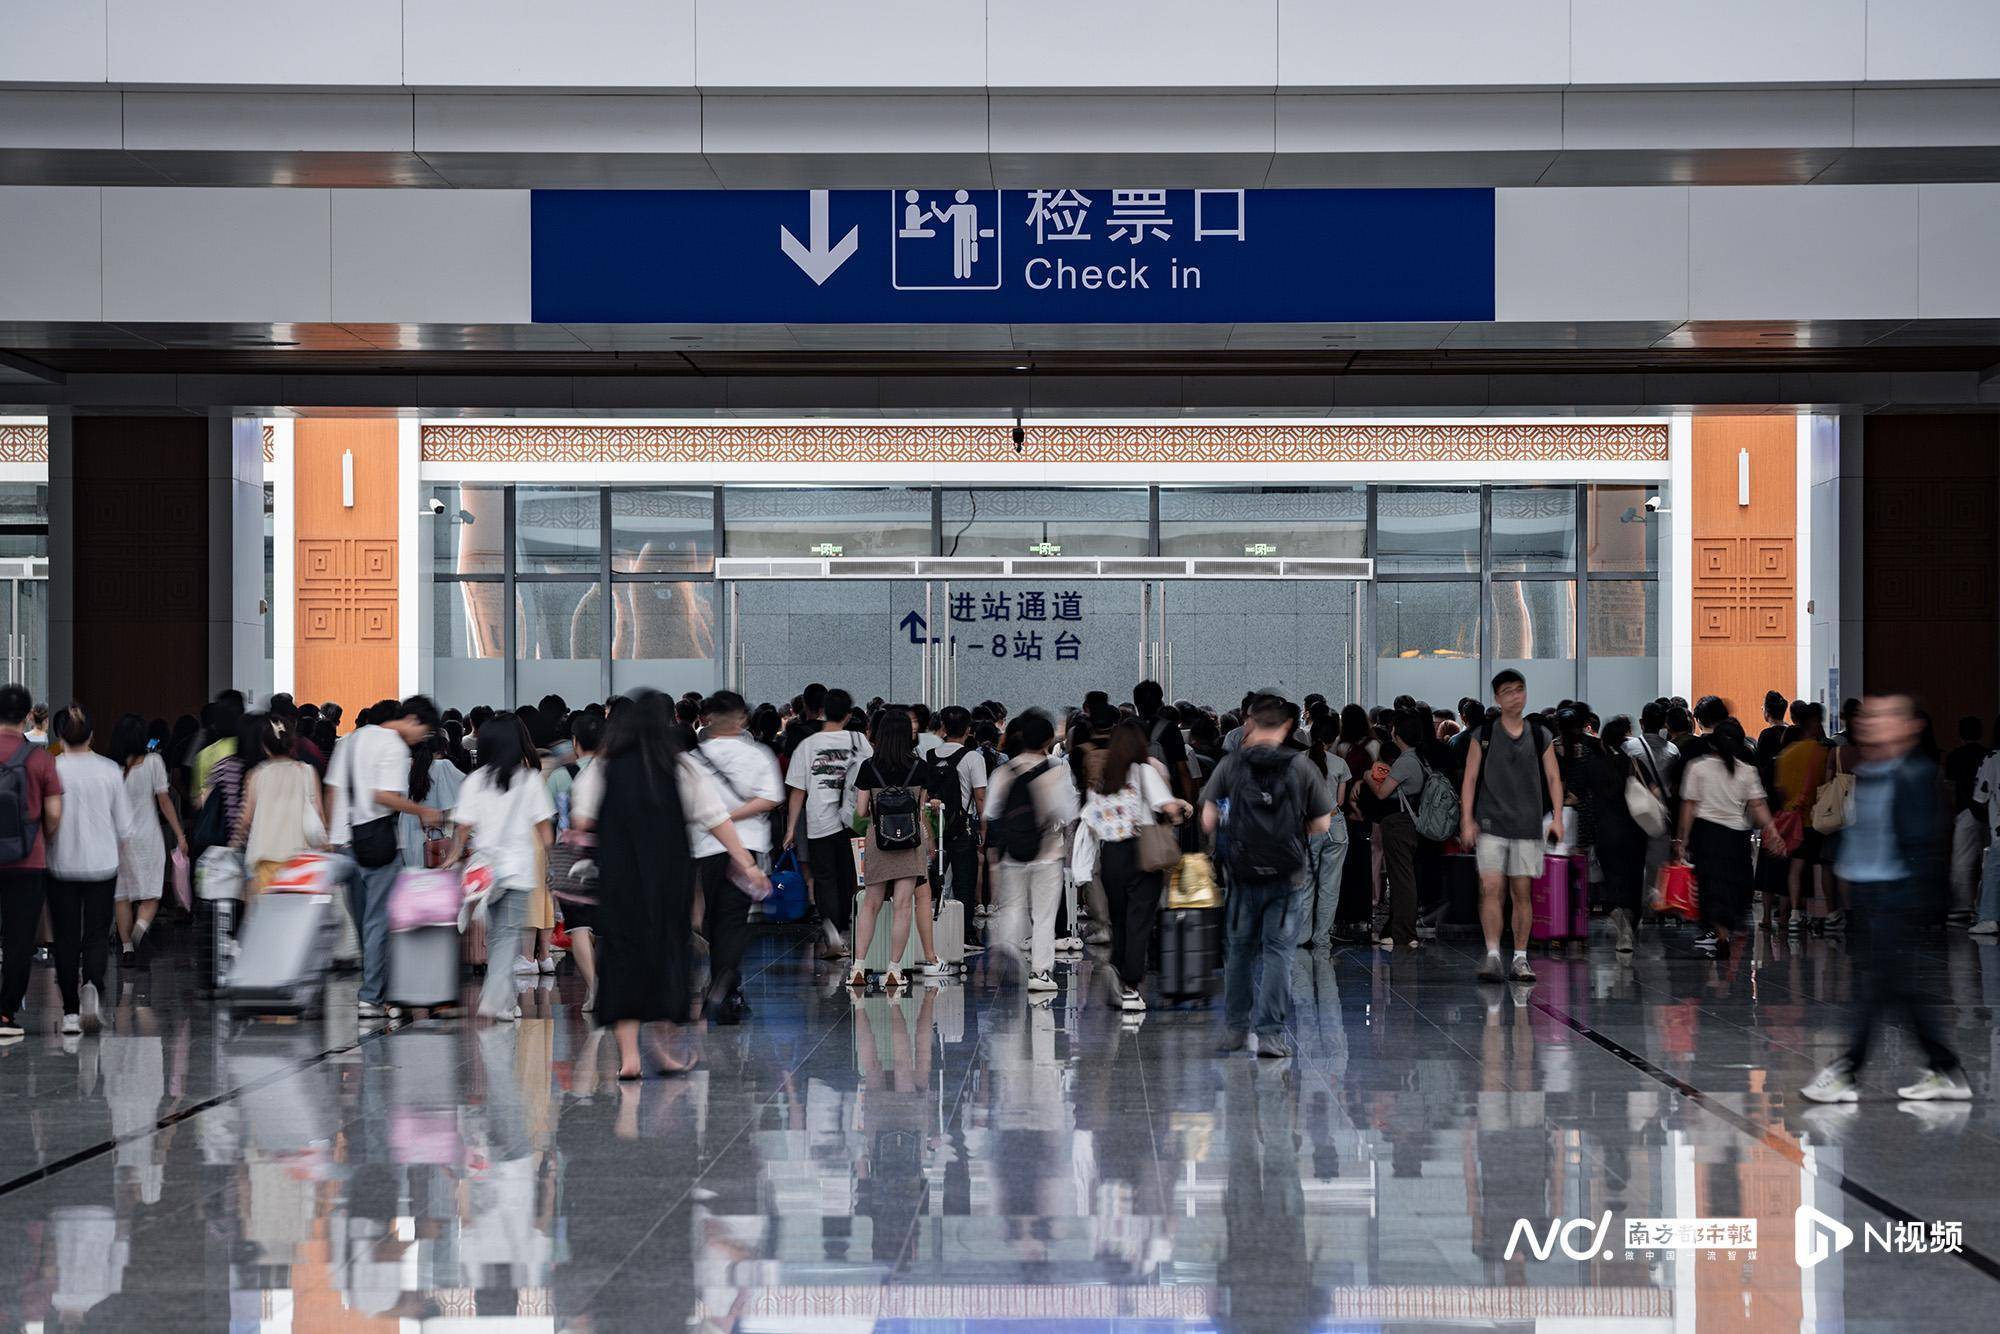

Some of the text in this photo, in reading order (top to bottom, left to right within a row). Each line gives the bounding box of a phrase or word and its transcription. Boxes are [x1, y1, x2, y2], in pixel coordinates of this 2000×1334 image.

[1025, 188, 1246, 245] 检票口
[1024, 257, 1201, 290] Check in
[950, 590, 1083, 622] 进站通道
